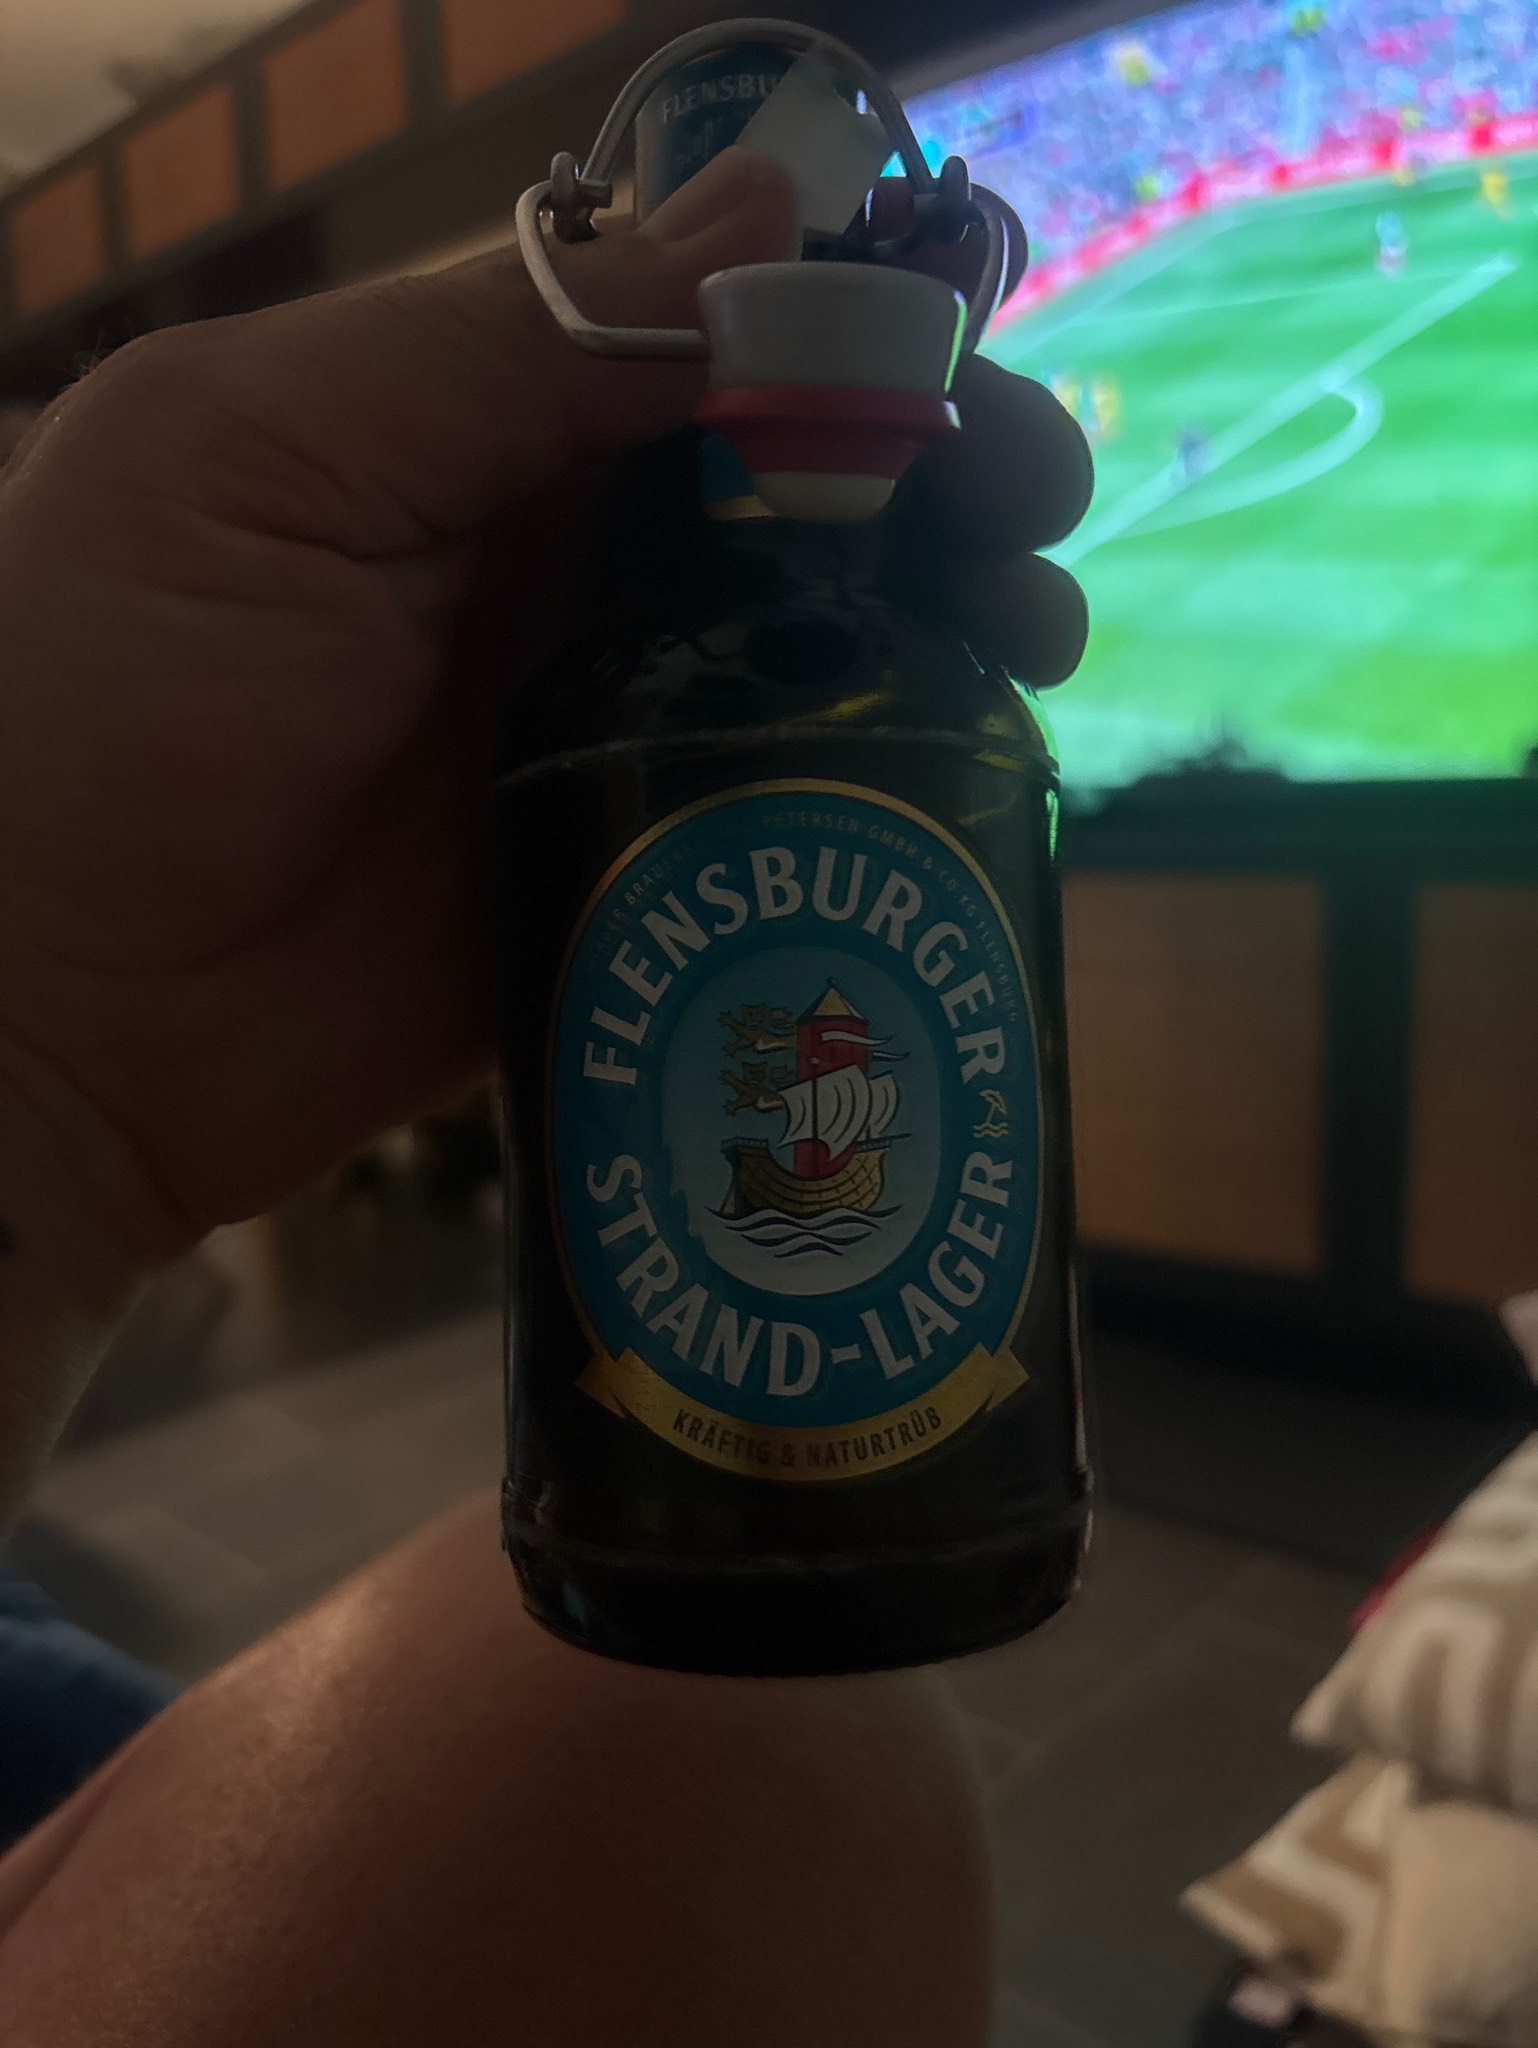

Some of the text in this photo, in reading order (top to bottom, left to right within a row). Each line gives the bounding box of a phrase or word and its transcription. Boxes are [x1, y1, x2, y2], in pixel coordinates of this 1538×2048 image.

[582, 845, 1007, 1086] FLENSBURGER
[586, 1150, 1014, 1397] STRAND-LAGER
[672, 1407, 941, 1467] KRÄFTIG & NATURTRÜB
